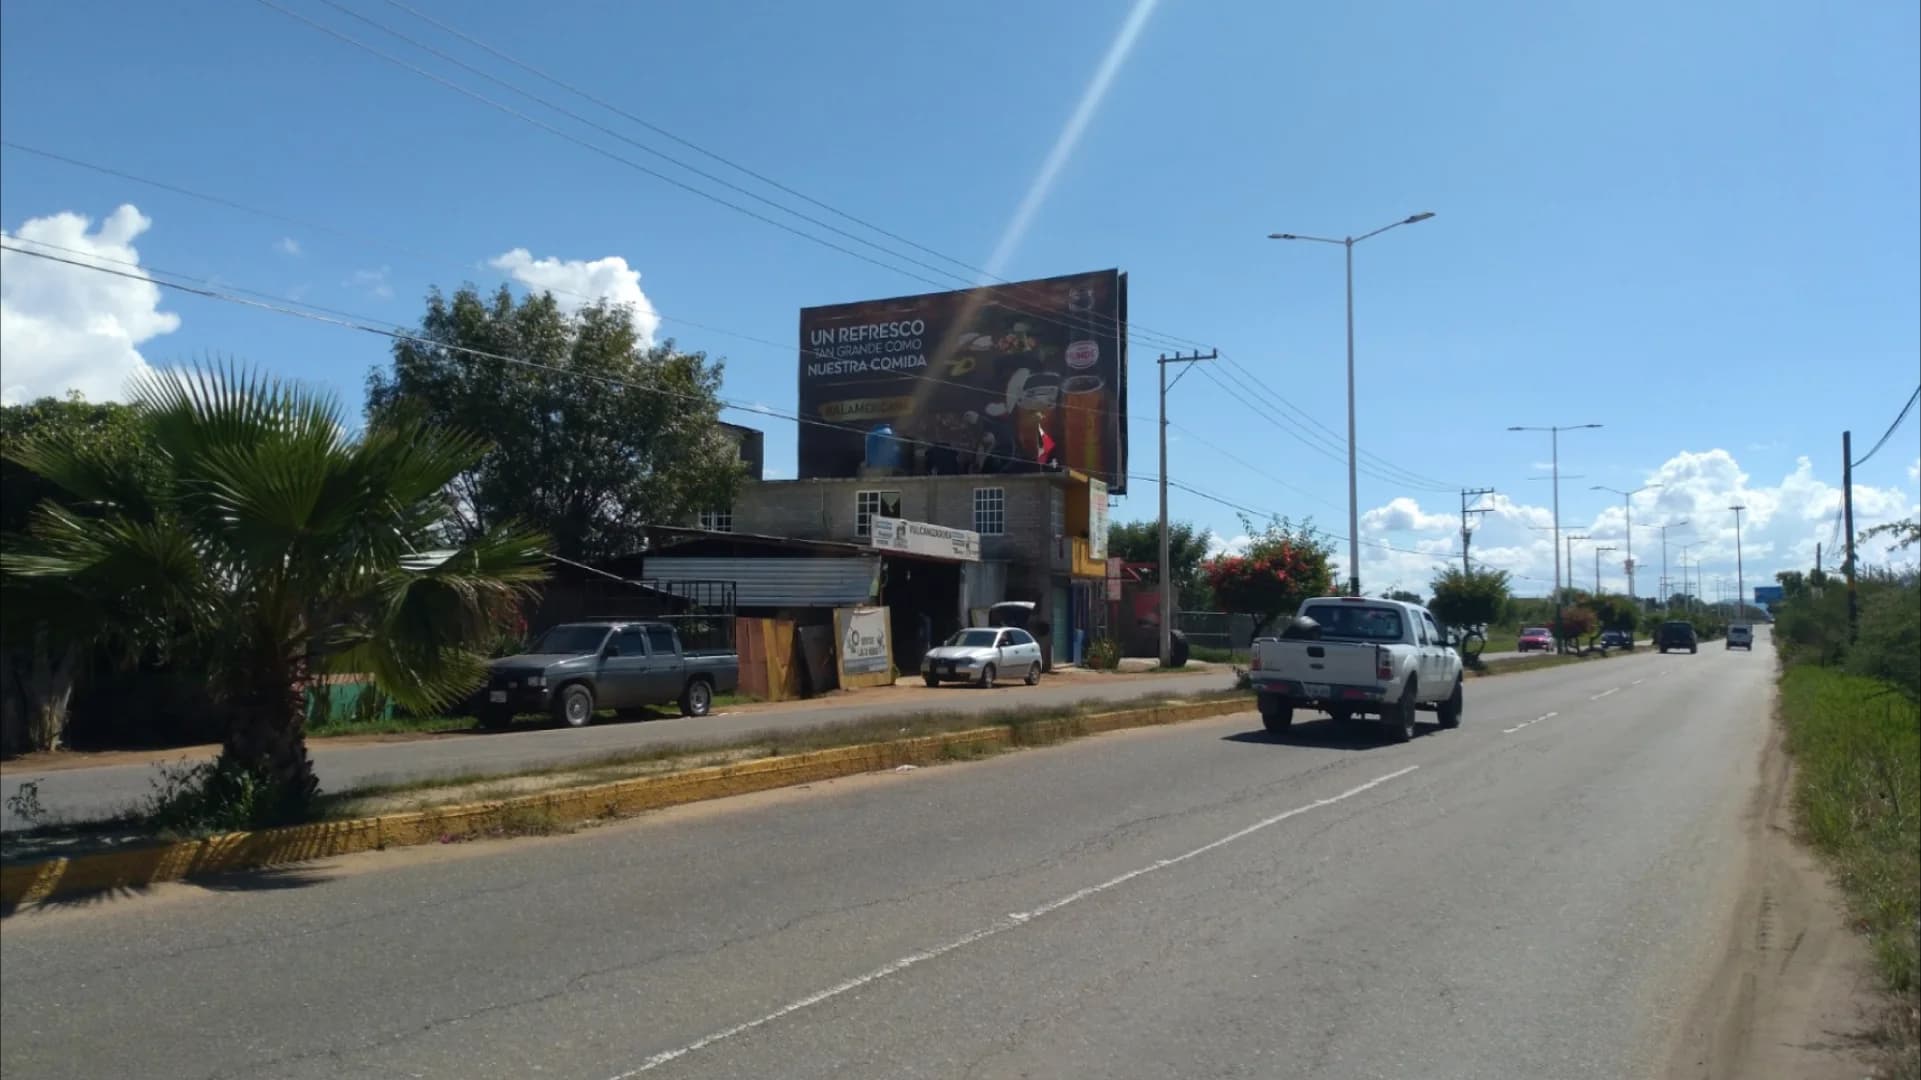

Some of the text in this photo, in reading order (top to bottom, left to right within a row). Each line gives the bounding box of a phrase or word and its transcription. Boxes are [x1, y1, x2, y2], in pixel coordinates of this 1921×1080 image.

[811, 320, 925, 345] UN REFRESCO
[815, 339, 922, 359] TAN GRANDE COMO
[807, 354, 927, 376] NUESTRA COMIDA
